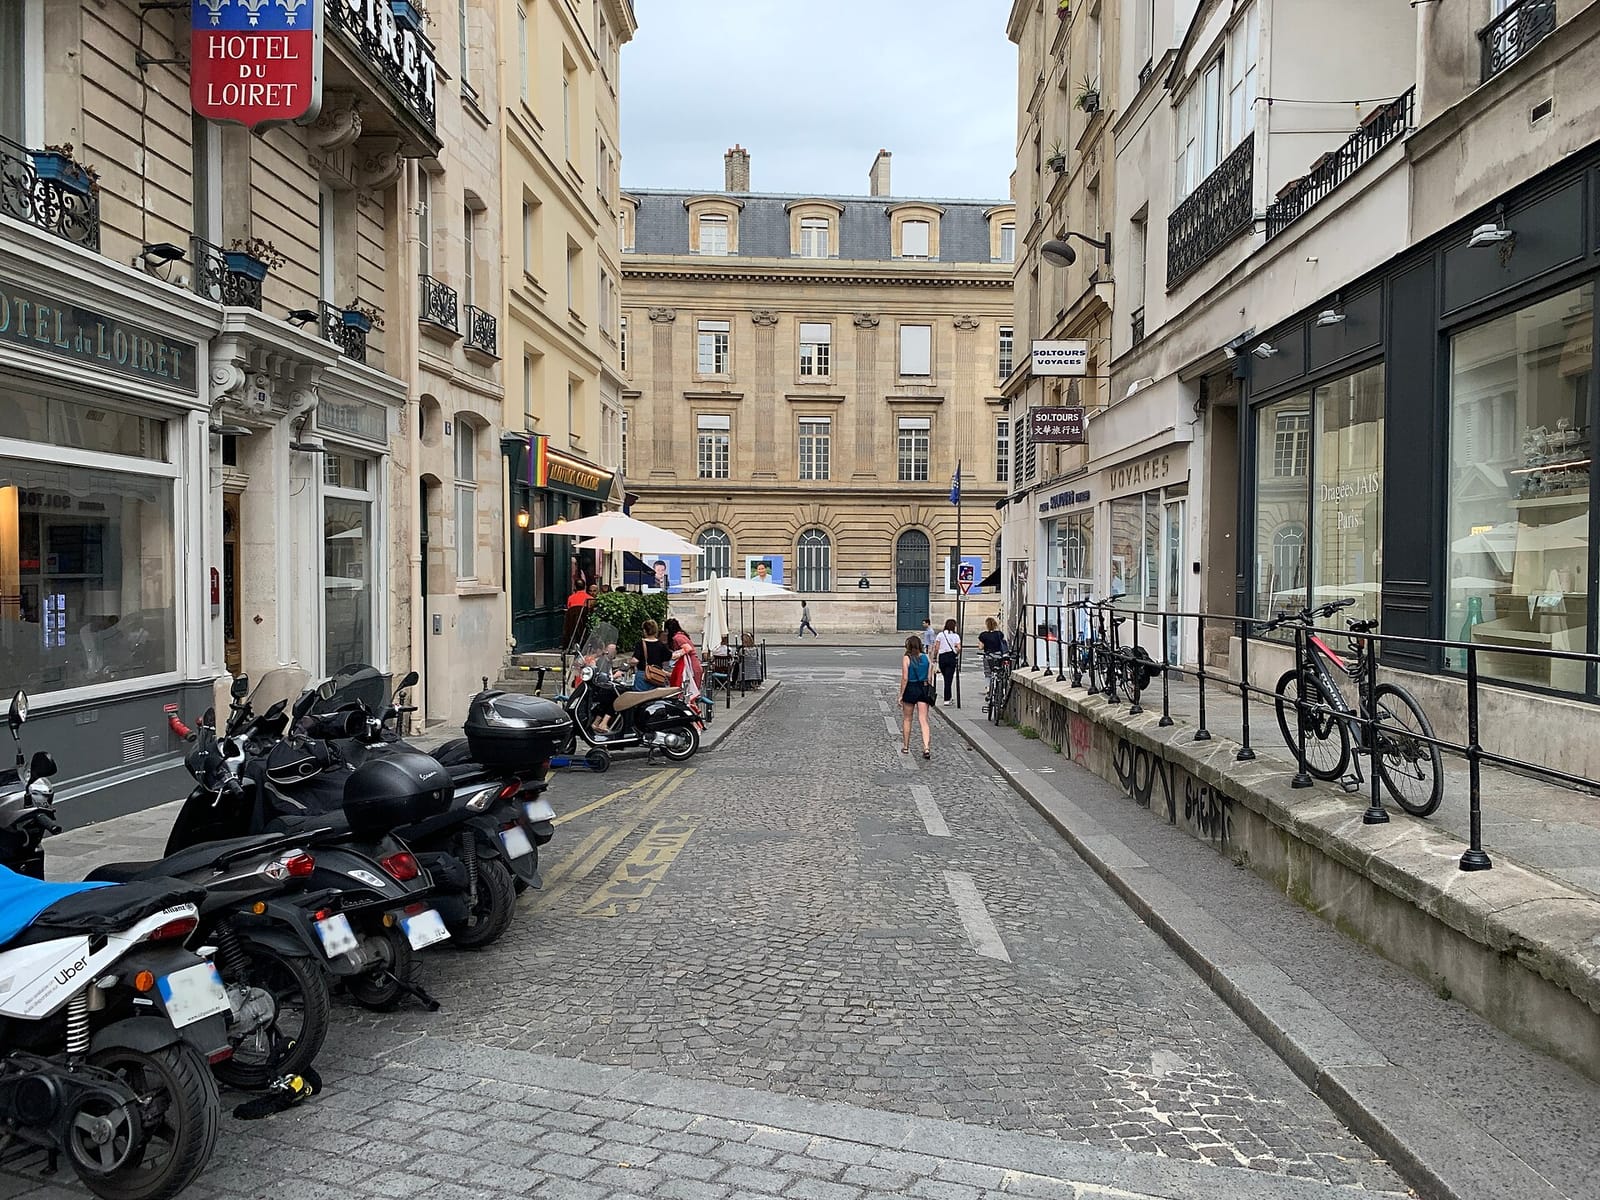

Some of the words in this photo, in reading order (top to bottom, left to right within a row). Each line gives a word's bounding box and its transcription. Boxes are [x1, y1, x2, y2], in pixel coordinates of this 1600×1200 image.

[208, 36, 299, 59] HOTEL
[348, 0, 436, 104] IRET
[239, 64, 266, 78] DU
[207, 83, 298, 106] LOIRET
[75, 326, 92, 354] du
[97, 322, 182, 380] LOIRET
[1035, 413, 1079, 422] SOLTOURS
[1110, 455, 1169, 491] VOYAGES
[1320, 480, 1354, 505] Dragées
[1355, 472, 1379, 496] JAIS
[1336, 509, 1359, 530] Paris
[162, 905, 186, 915] Allianz
[54, 956, 88, 987] Uber
